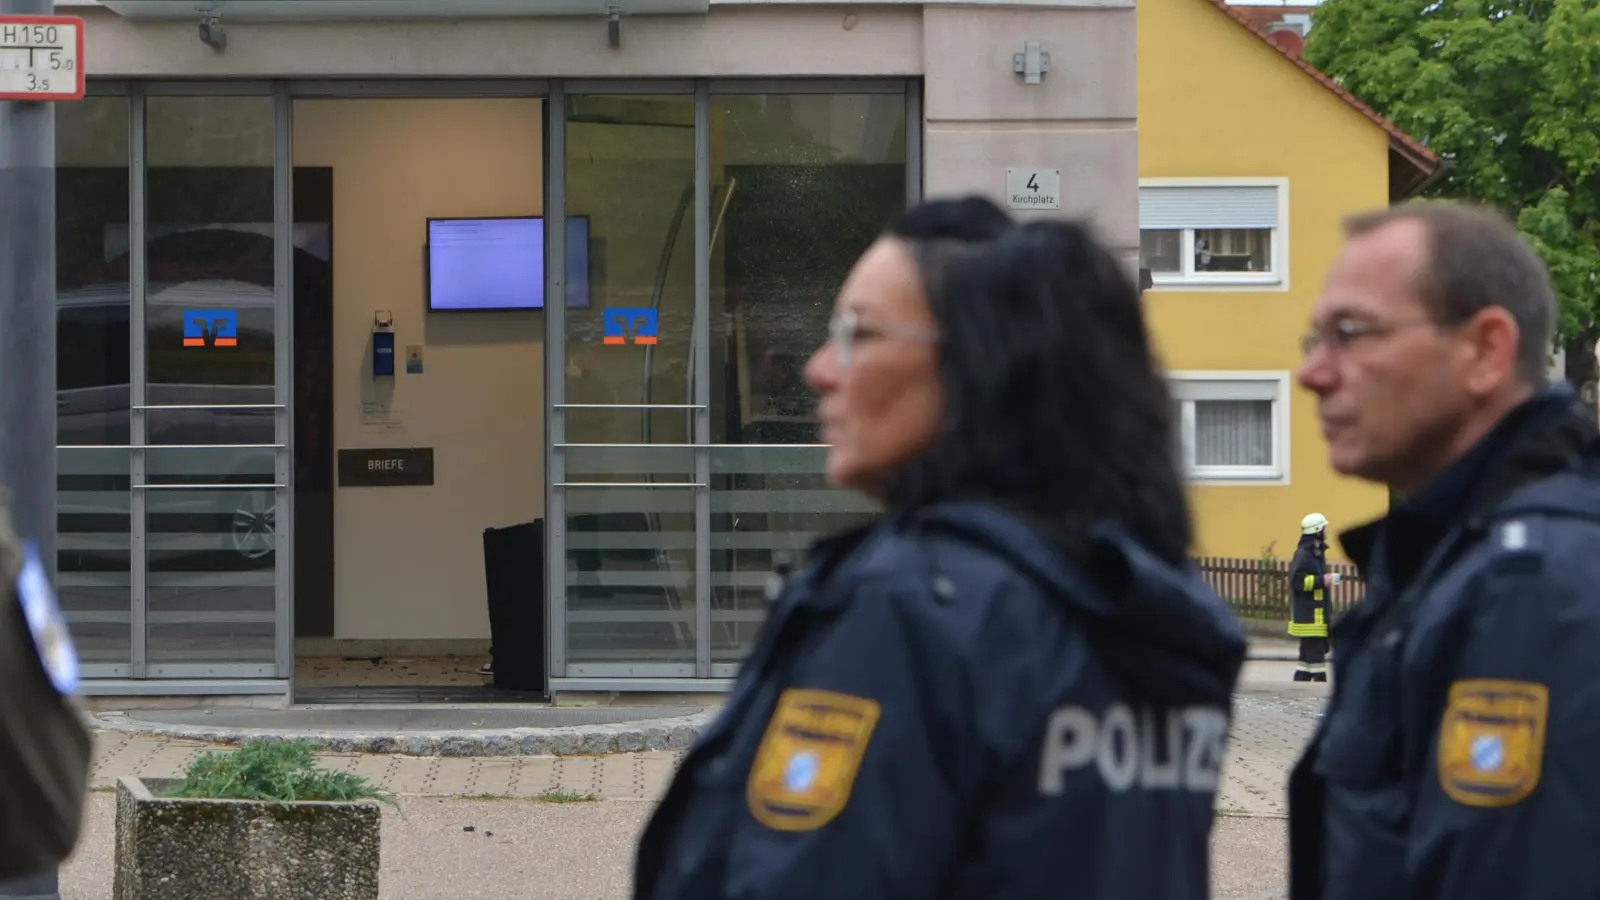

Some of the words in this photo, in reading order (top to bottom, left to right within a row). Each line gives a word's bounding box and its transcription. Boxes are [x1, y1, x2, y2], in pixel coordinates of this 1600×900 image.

[4, 25, 57, 44] H150
[1026, 173, 1039, 192] 4
[1012, 194, 1054, 205] Kirchplatz
[367, 459, 404, 470] BRIEFE
